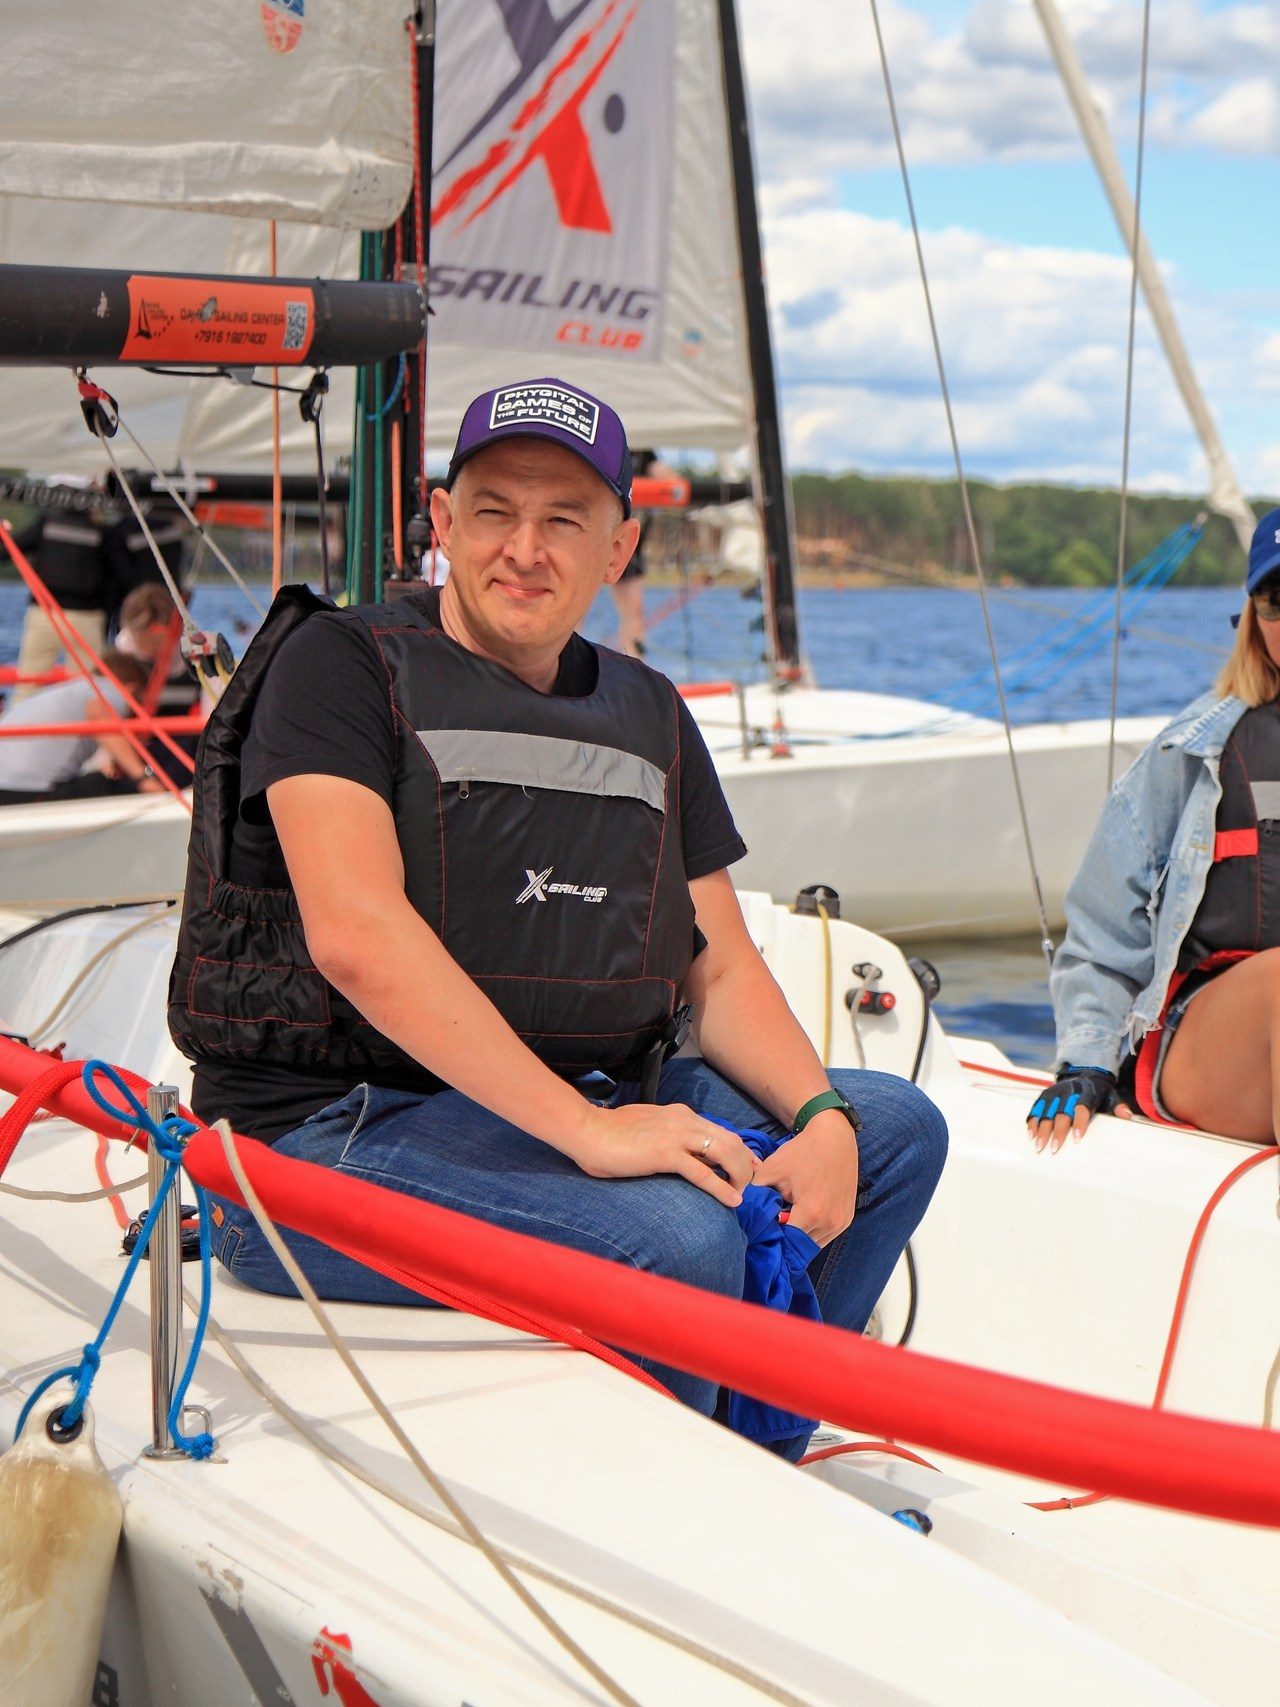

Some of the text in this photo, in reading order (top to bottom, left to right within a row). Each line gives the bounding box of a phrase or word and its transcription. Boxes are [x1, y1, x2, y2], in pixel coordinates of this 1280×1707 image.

[428, 264, 660, 320] SAILING
[251, 311, 285, 326] CENTER
[556, 319, 644, 352] CLUB
[497, 398, 592, 425] GAMES OF
[504, 389, 589, 413] PHYGITAL
[496, 408, 591, 436] THE FUTURE
